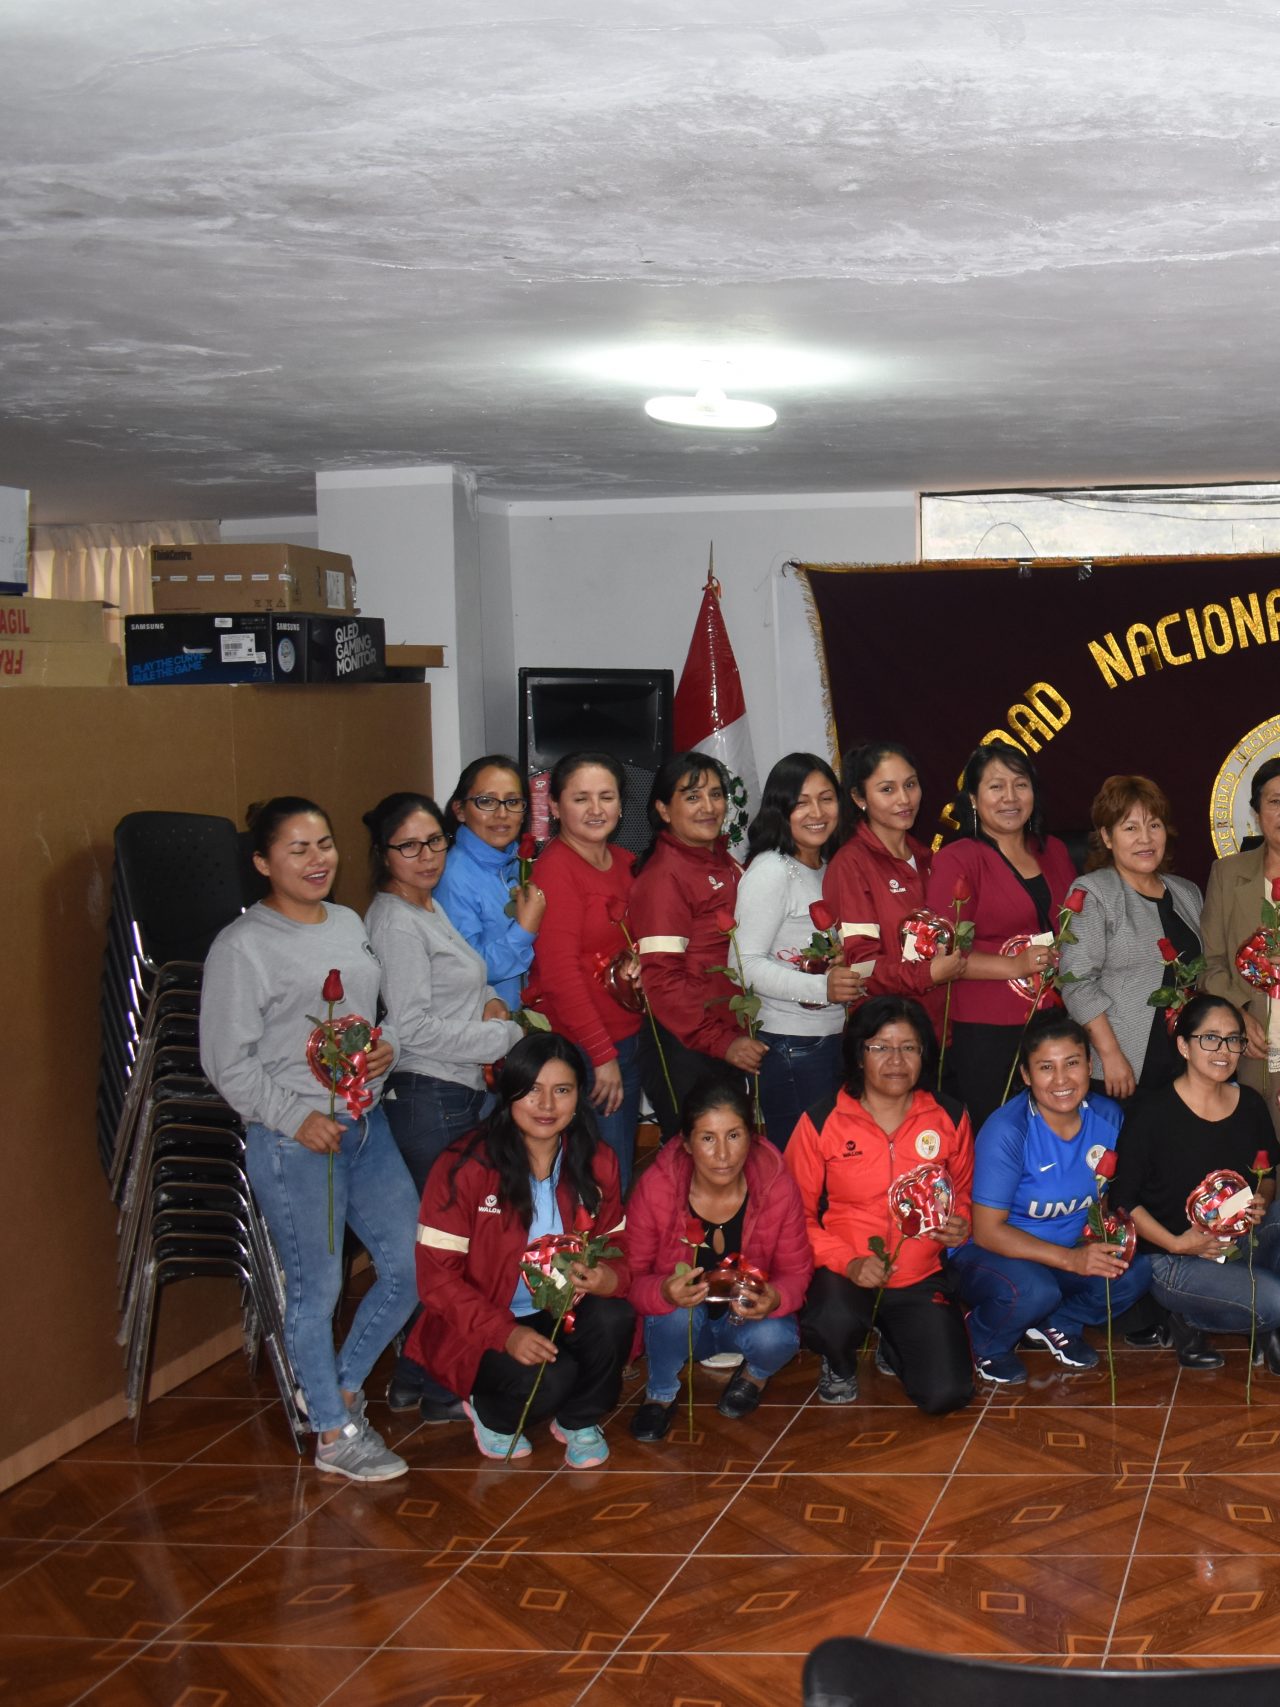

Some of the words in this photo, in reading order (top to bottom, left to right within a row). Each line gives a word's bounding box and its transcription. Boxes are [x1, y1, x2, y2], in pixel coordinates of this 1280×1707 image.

[276, 622, 300, 631] SAMSUNG
[335, 623, 359, 643] QLED
[335, 634, 372, 659] GAMING
[336, 648, 377, 677] MONITOR
[478, 1206, 502, 1214] WALON
[1028, 1195, 1094, 1219] UNA
